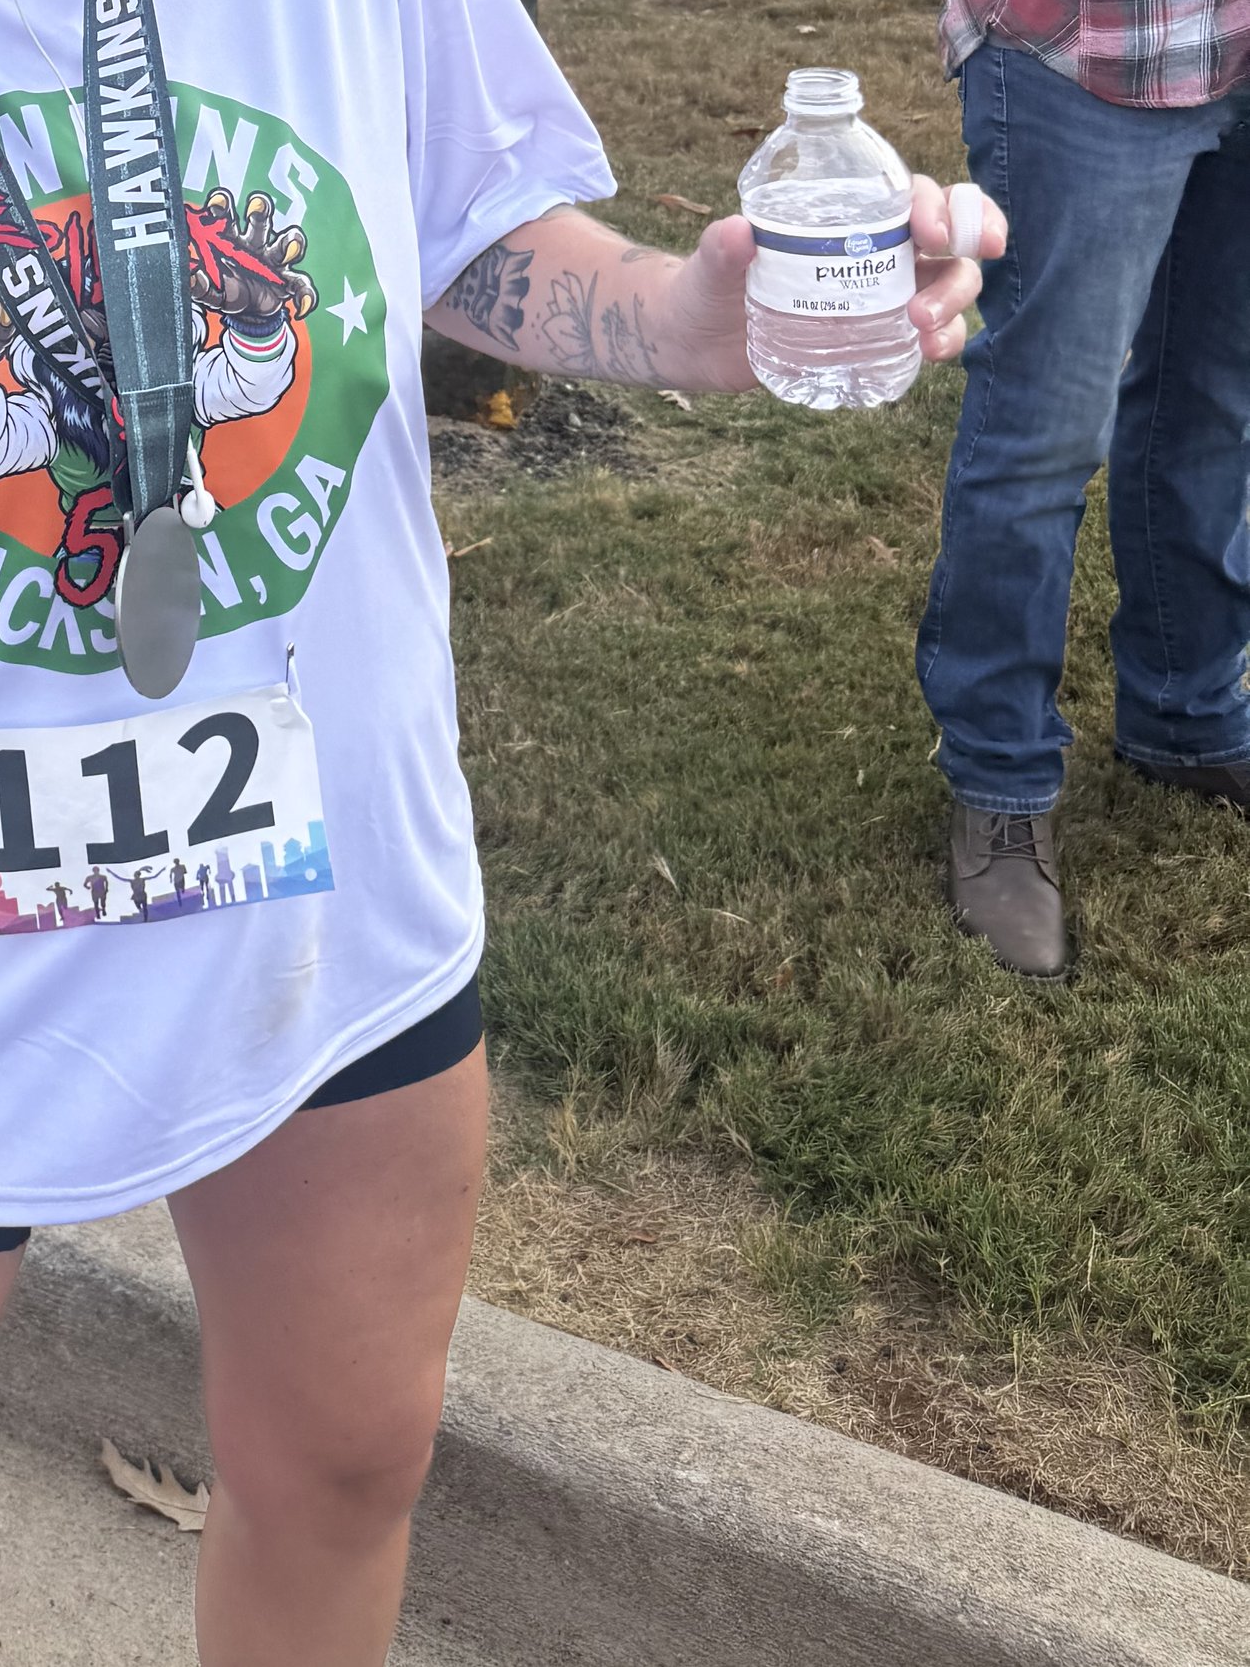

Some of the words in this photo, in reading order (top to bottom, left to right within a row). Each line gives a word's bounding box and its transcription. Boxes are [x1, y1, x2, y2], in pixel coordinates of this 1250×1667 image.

[815, 254, 896, 282] purified
[839, 277, 880, 290] WATER
[2, 253, 104, 400] KINS
[257, 455, 347, 571] GA
